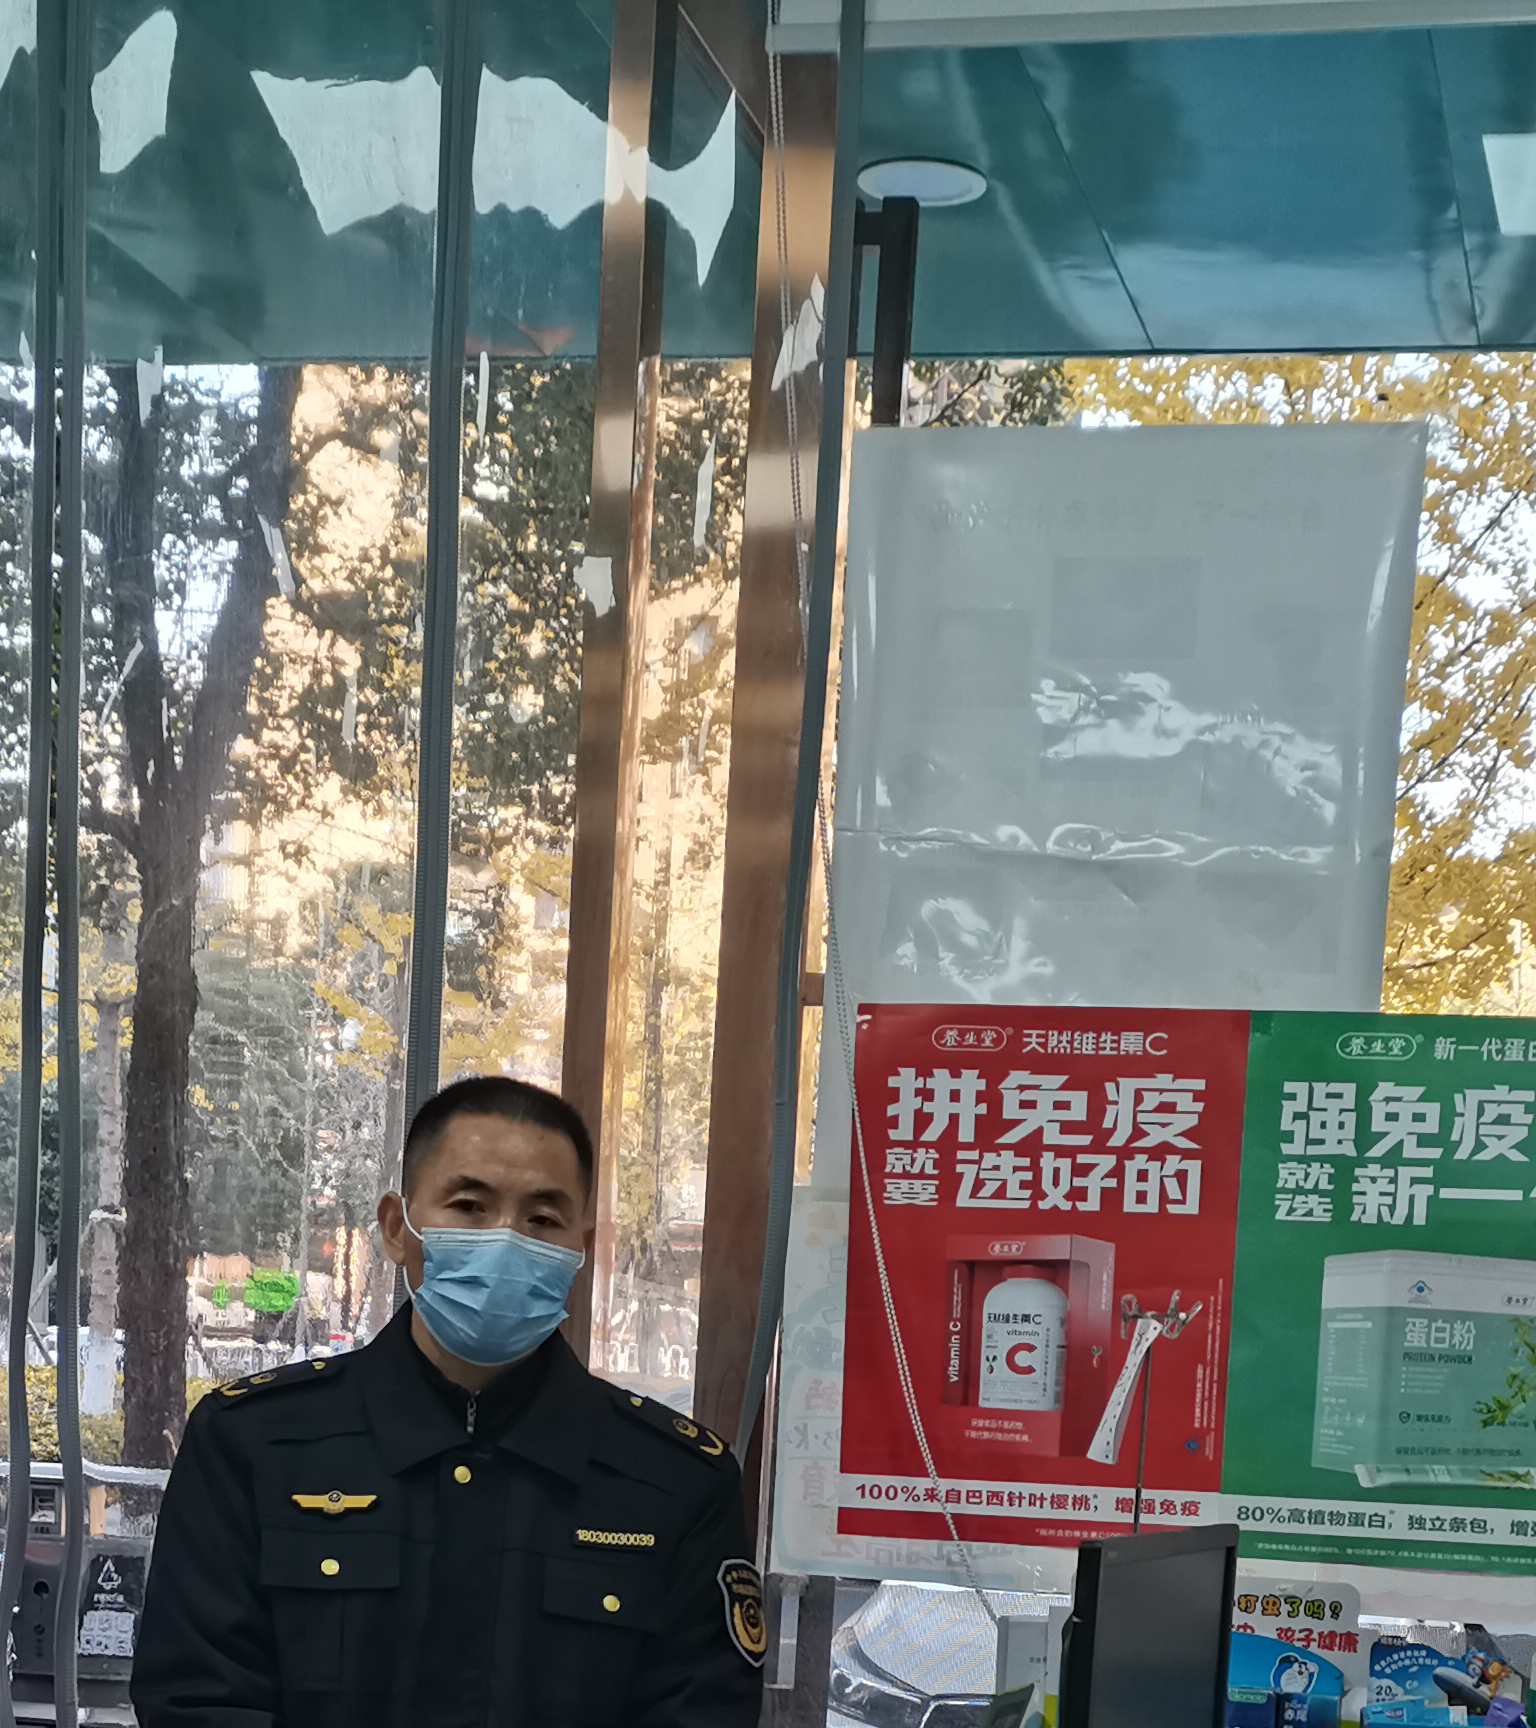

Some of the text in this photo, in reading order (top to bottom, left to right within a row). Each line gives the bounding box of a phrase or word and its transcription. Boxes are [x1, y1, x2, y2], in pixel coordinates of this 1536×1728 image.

[1021, 1028, 1170, 1056] 天然维生素C
[886, 1066, 1207, 1150] 拼免疫
[955, 1149, 1203, 1216] 选好的
[1403, 1317, 1476, 1351] 蛋白粉
